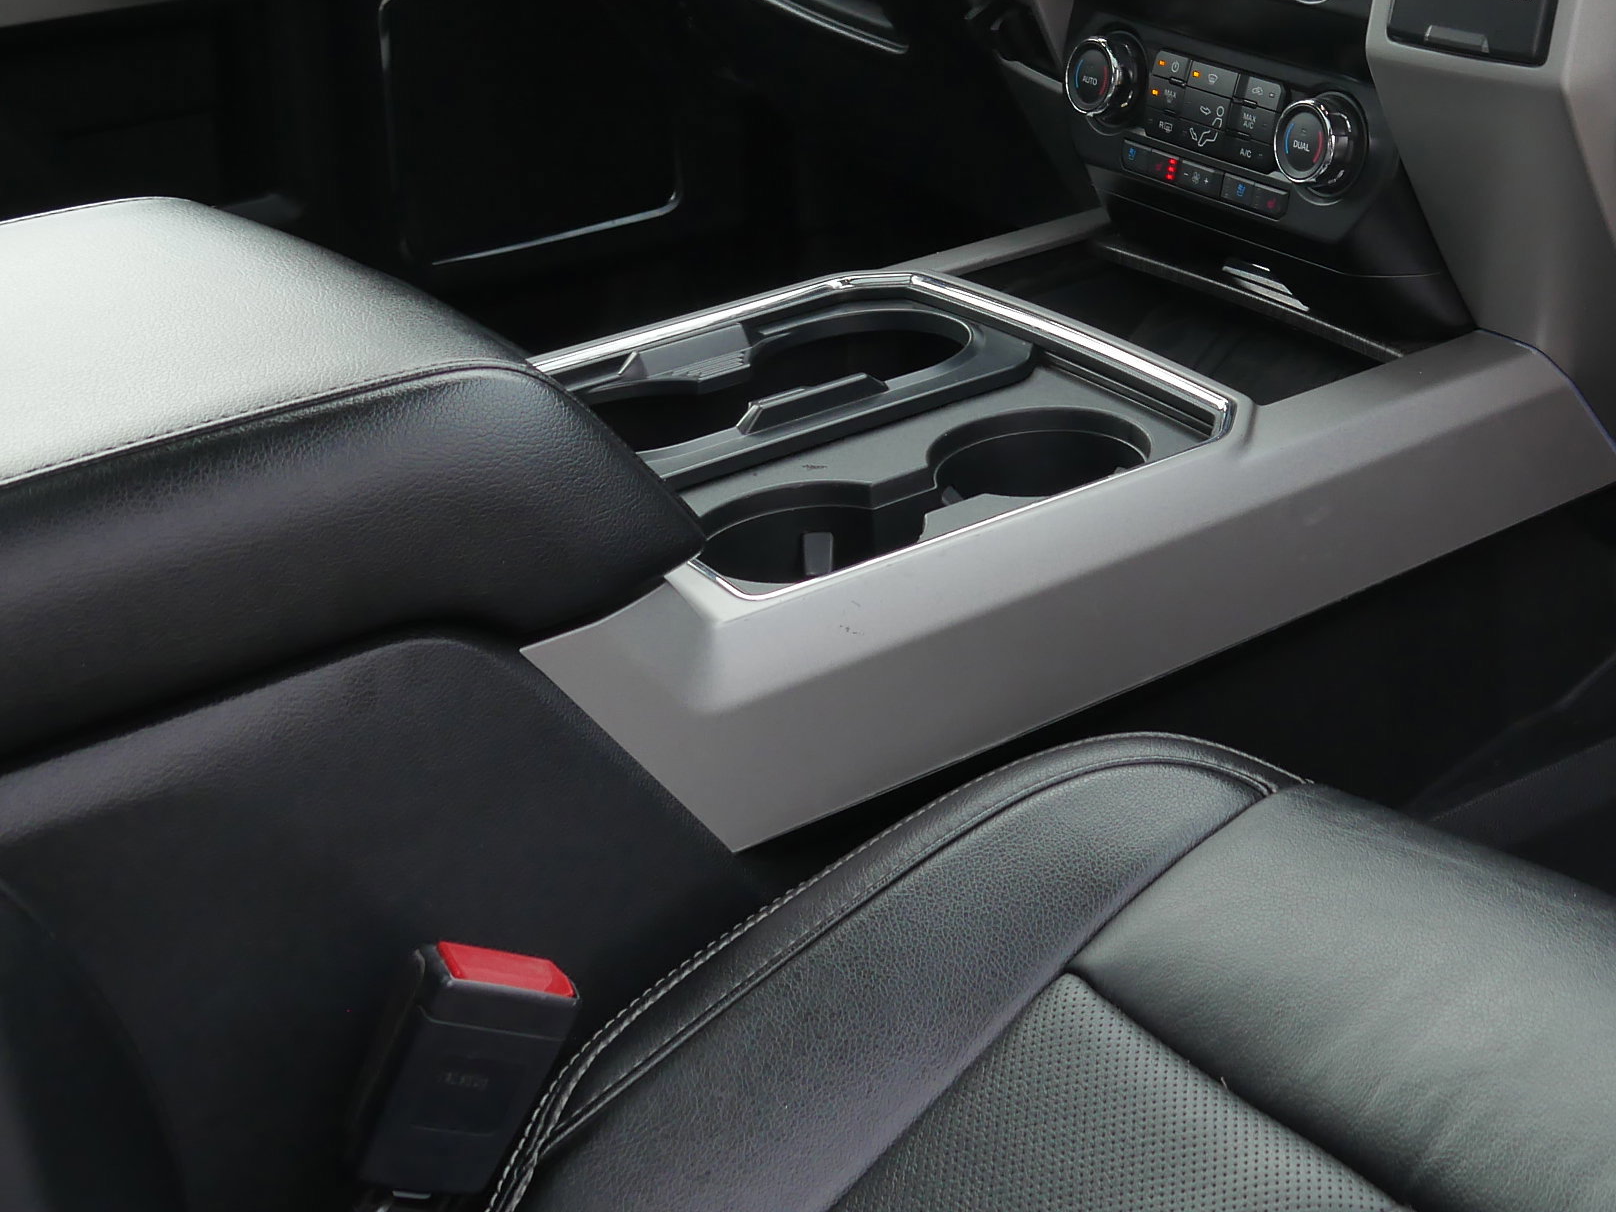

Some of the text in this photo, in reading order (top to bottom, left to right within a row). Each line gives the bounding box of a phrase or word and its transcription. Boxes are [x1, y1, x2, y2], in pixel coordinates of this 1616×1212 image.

[1082, 75, 1098, 86] AUTO
[1164, 88, 1177, 99] MAX
[1243, 112, 1257, 124] MAX
[1243, 121, 1255, 130] A/C
[1292, 139, 1310, 153] DUAL
[1239, 147, 1252, 159] A/C
